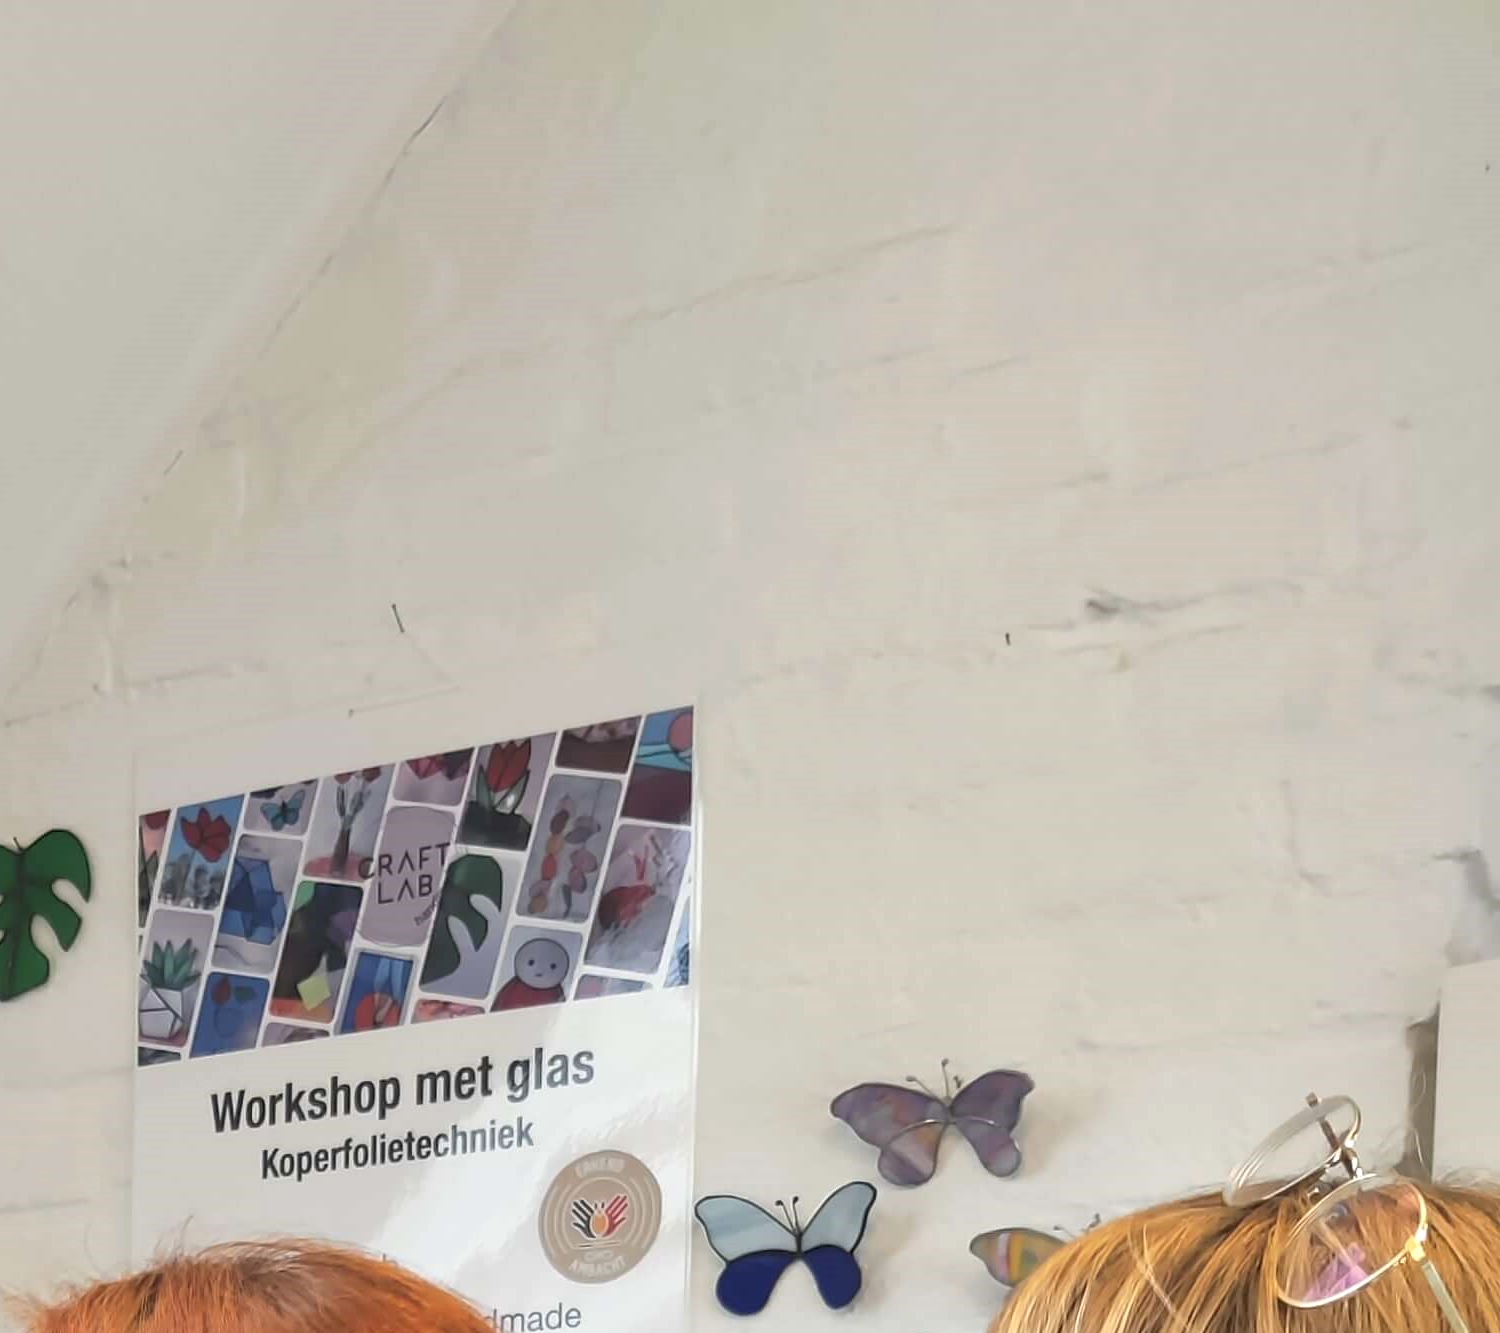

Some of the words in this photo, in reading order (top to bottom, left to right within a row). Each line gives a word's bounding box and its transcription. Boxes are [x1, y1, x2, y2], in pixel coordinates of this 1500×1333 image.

[358, 842, 450, 879] CRAFT
[378, 874, 433, 905] LAB
[211, 1075, 400, 1133] Workshop
[415, 1055, 493, 1106] met
[506, 1047, 595, 1102] glas
[261, 1116, 534, 1182] Koperfolietechniek
